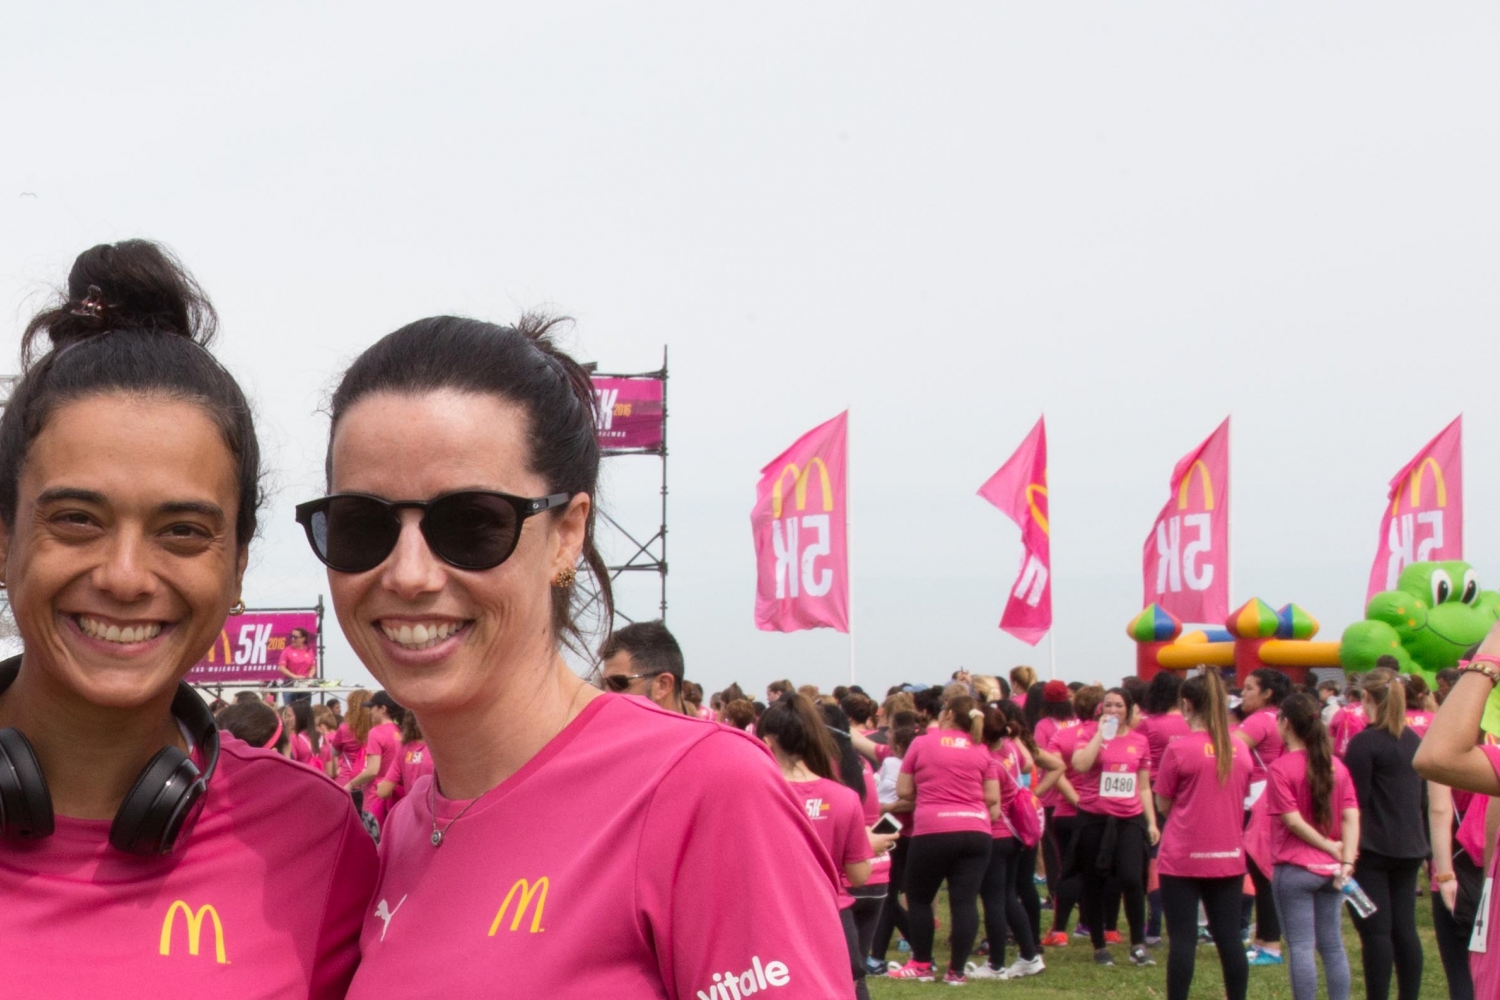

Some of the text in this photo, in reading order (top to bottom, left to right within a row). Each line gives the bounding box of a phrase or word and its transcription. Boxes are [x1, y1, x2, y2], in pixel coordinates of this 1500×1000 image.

[235, 623, 286, 665] 5K 2016
[1105, 777, 1133, 792] 0480
